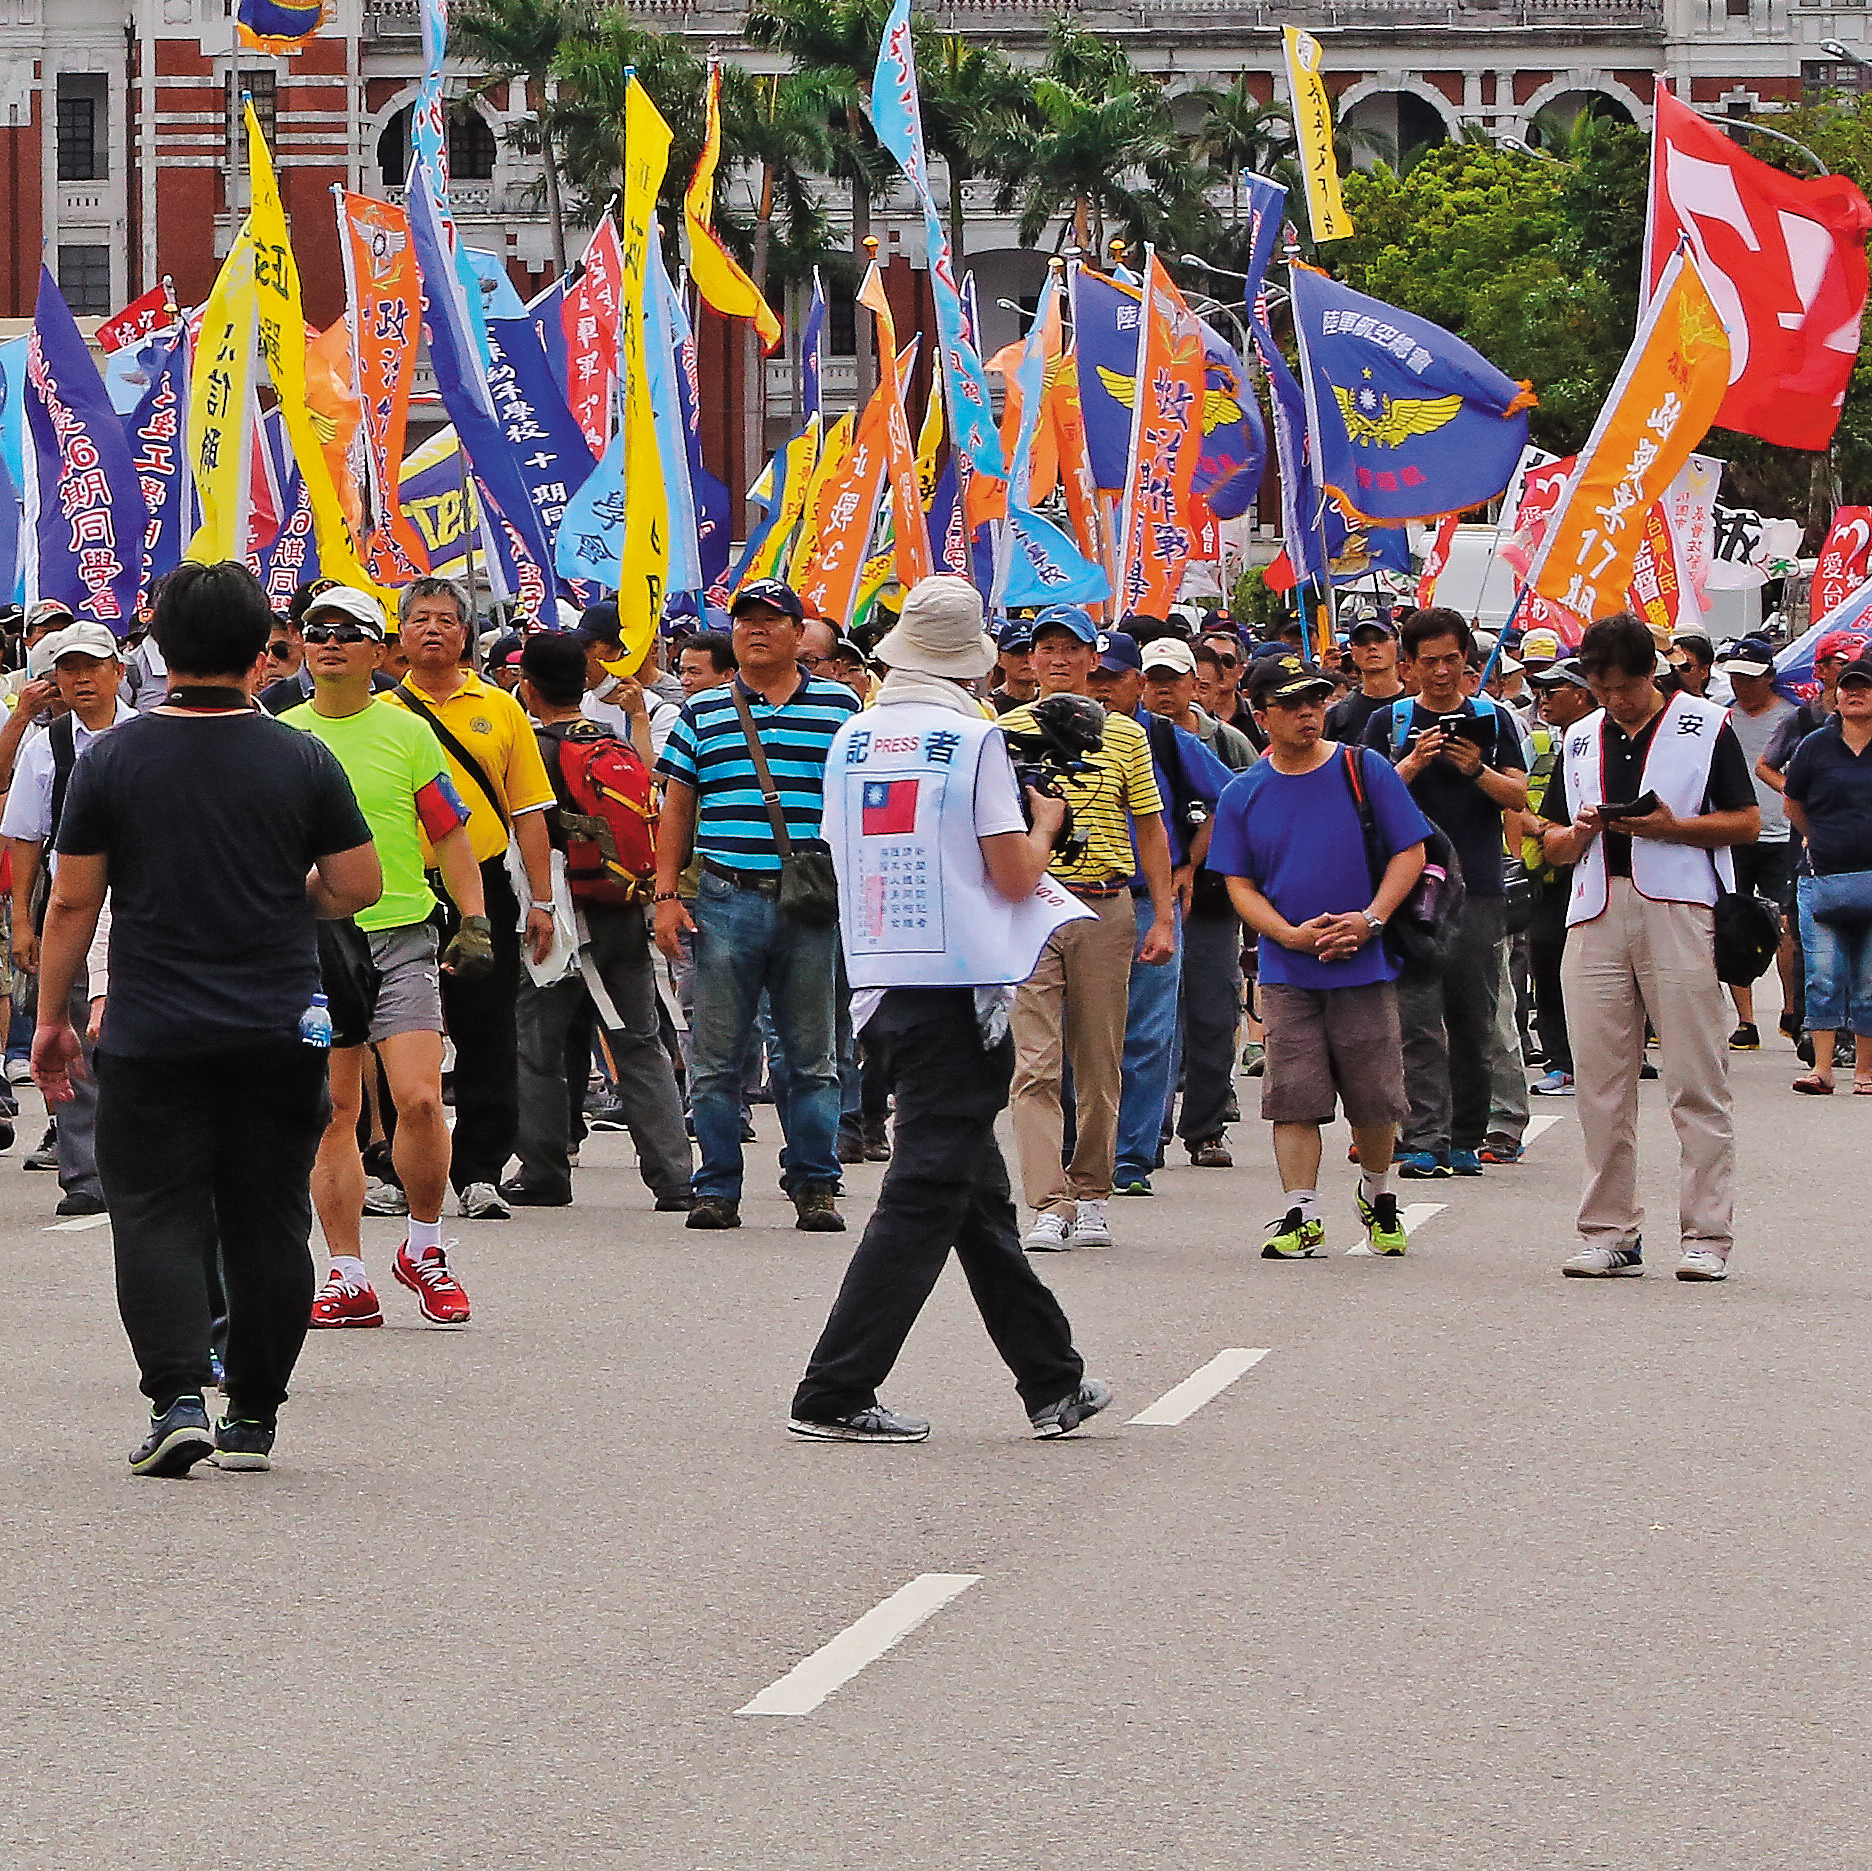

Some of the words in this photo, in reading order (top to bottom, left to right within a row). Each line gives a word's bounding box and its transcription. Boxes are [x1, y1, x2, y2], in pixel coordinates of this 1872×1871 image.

[1677, 713, 1704, 737] 安
[845, 730, 869, 766] 記
[873, 734, 920, 756] PRESS
[925, 729, 960, 766] 者
